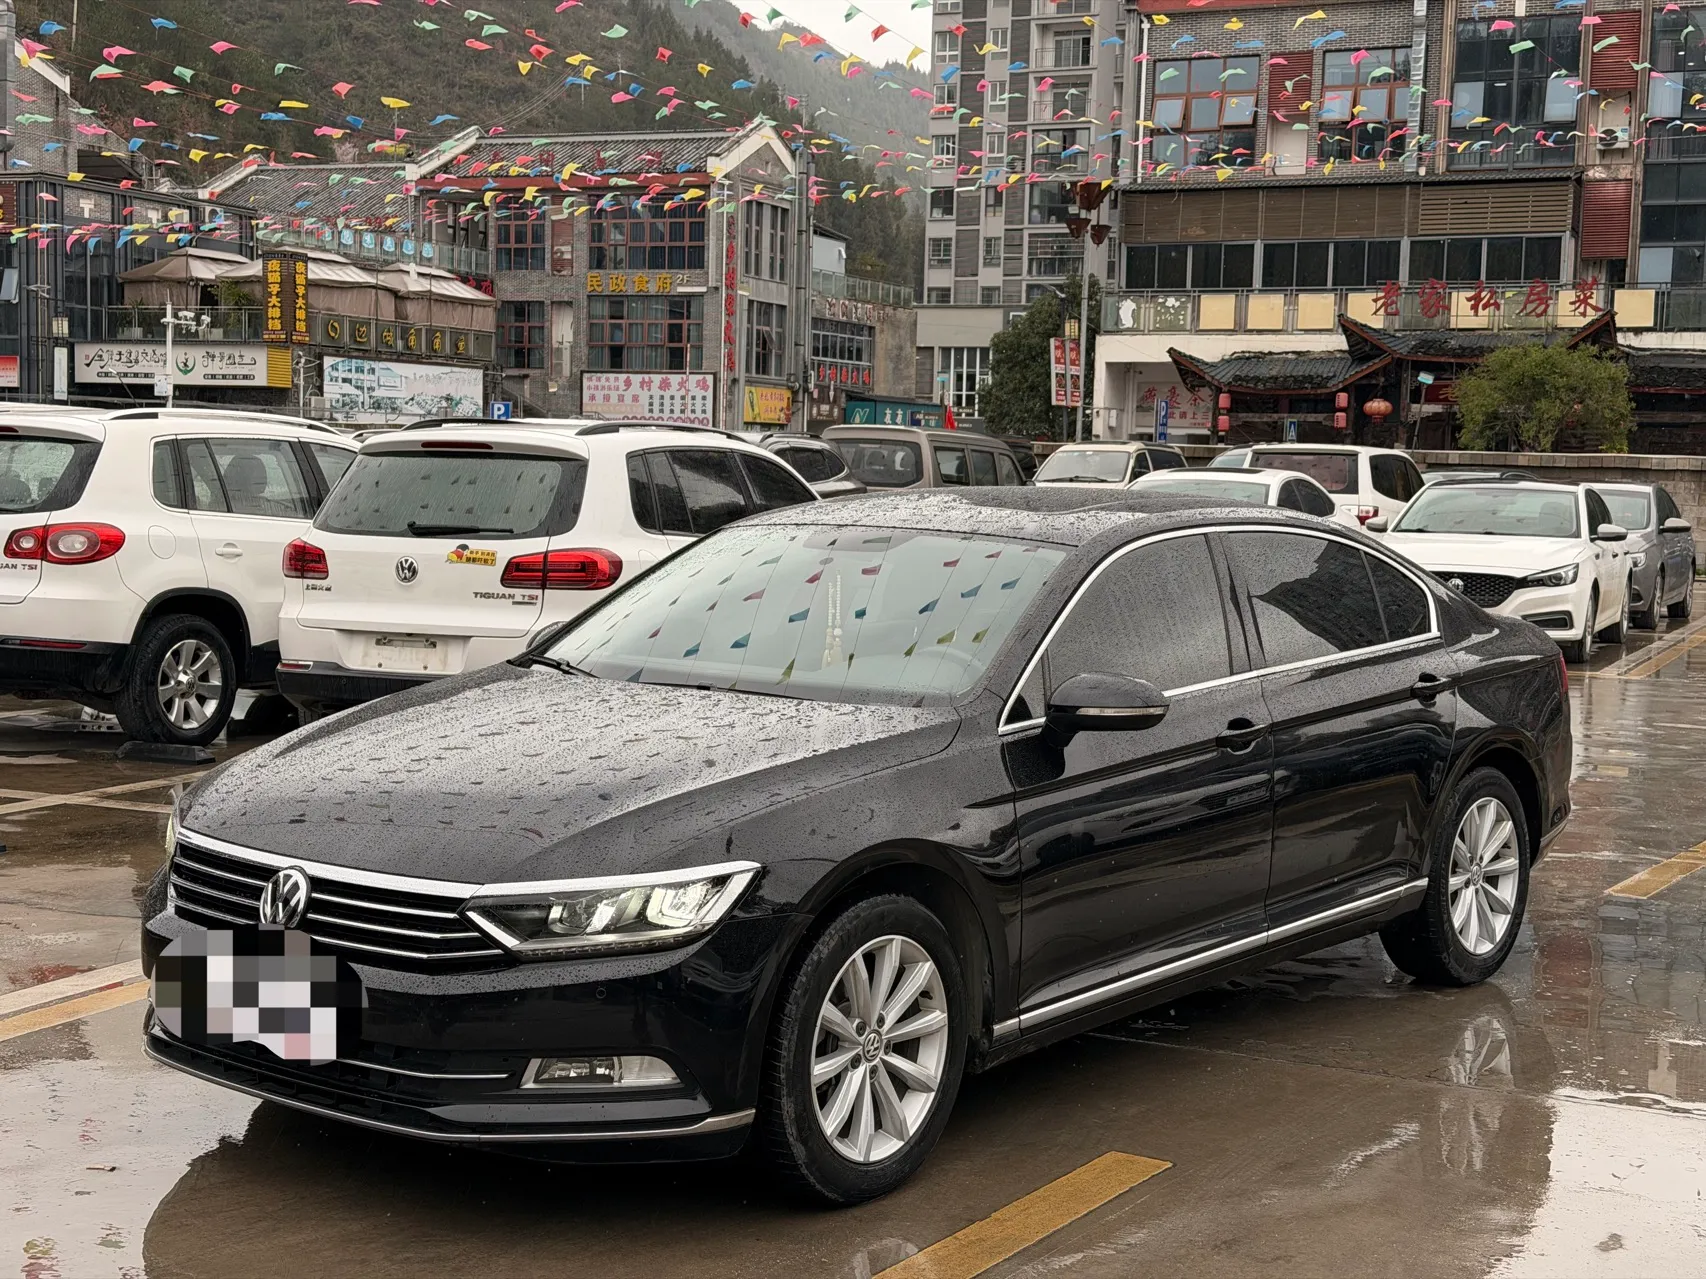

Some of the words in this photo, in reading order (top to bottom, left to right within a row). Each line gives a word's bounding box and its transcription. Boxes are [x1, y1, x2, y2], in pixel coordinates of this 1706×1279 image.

[587, 271, 673, 293] 民政食府
[676, 274, 692, 285] 2F
[267, 260, 282, 330] 夜猫子大排档
[295, 262, 307, 331] 夜猫子大排档
[1371, 276, 1604, 319] 老家私房菜
[622, 375, 711, 393] 乡村柴火鸡
[493, 403, 505, 419] P
[473, 591, 516, 600] TIGUAN
